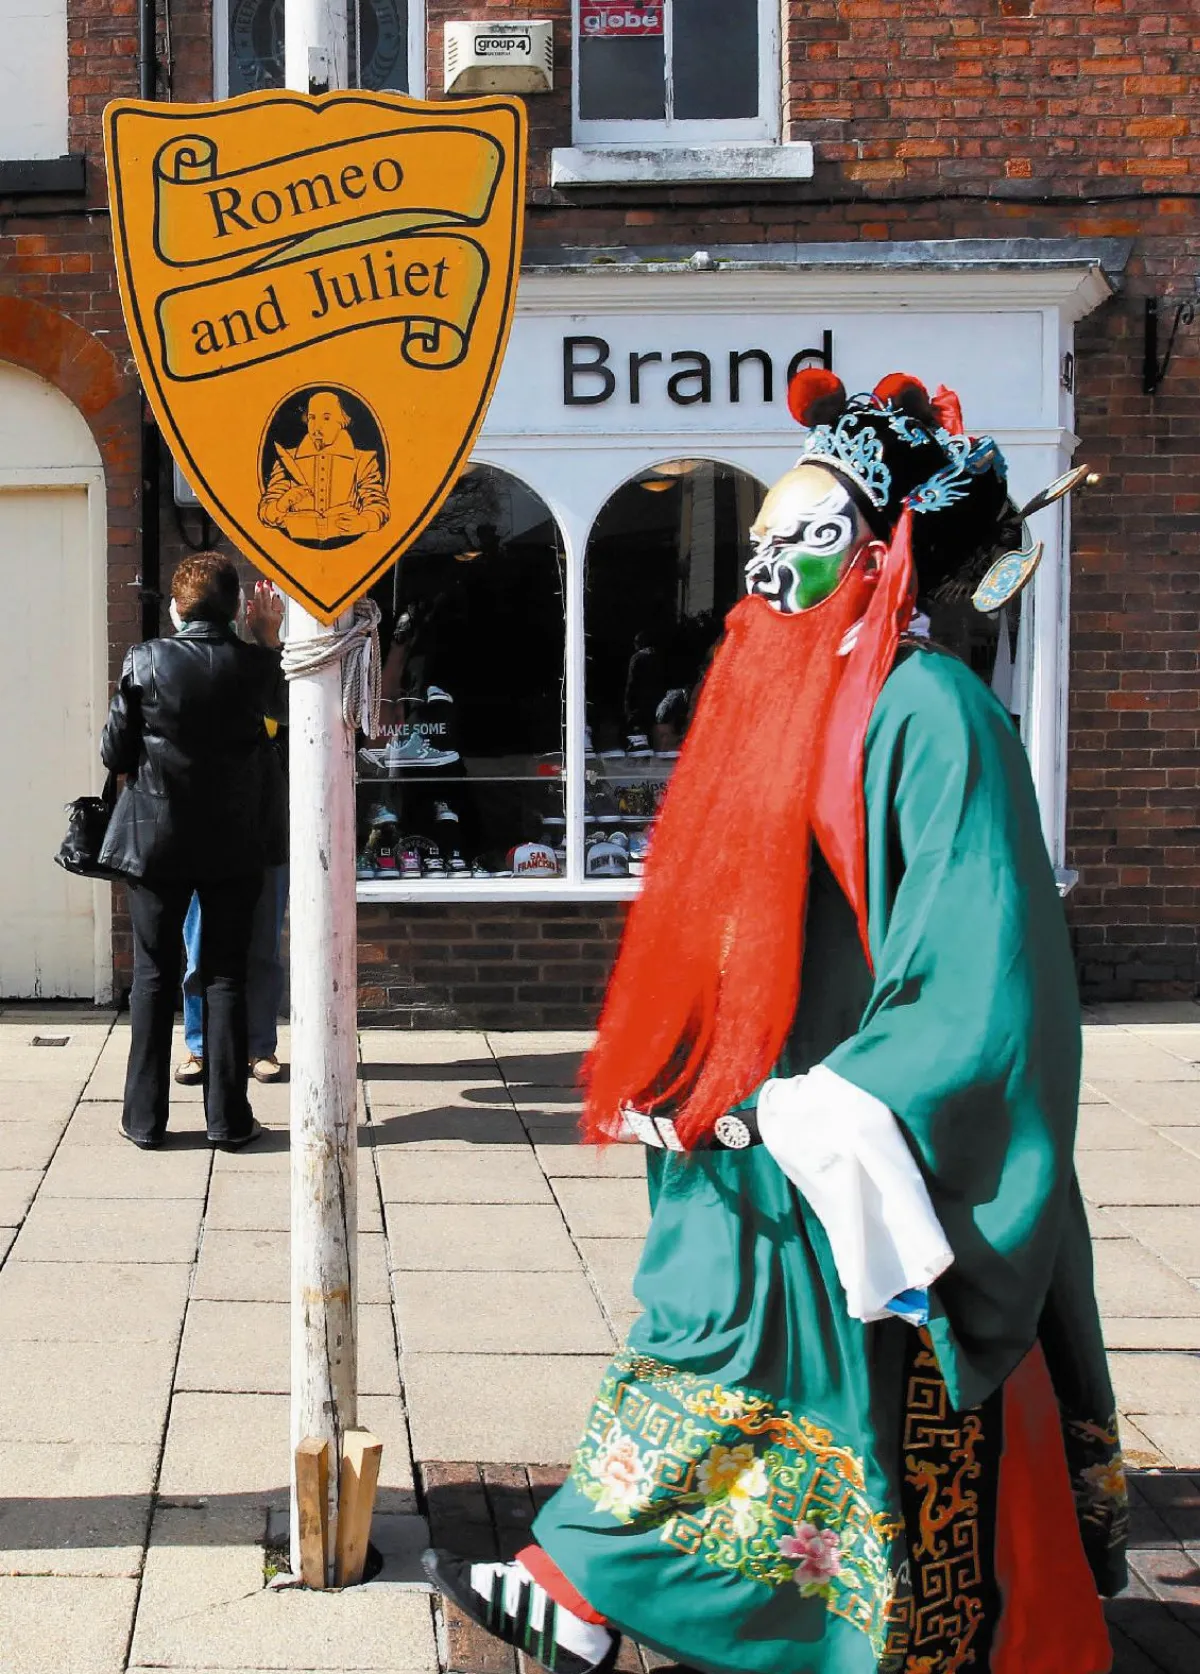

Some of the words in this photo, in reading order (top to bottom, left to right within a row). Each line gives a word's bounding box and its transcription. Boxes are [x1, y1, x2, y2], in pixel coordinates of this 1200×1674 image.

[584, 10, 658, 32] globe
[478, 40, 515, 51] group
[516, 40, 526, 50] 4
[204, 158, 404, 239] Romeo
[191, 285, 290, 355] and
[305, 250, 450, 318] Juliet
[377, 724, 409, 736] MAKE
[413, 722, 447, 735] SOME
[530, 852, 547, 860] SAN
